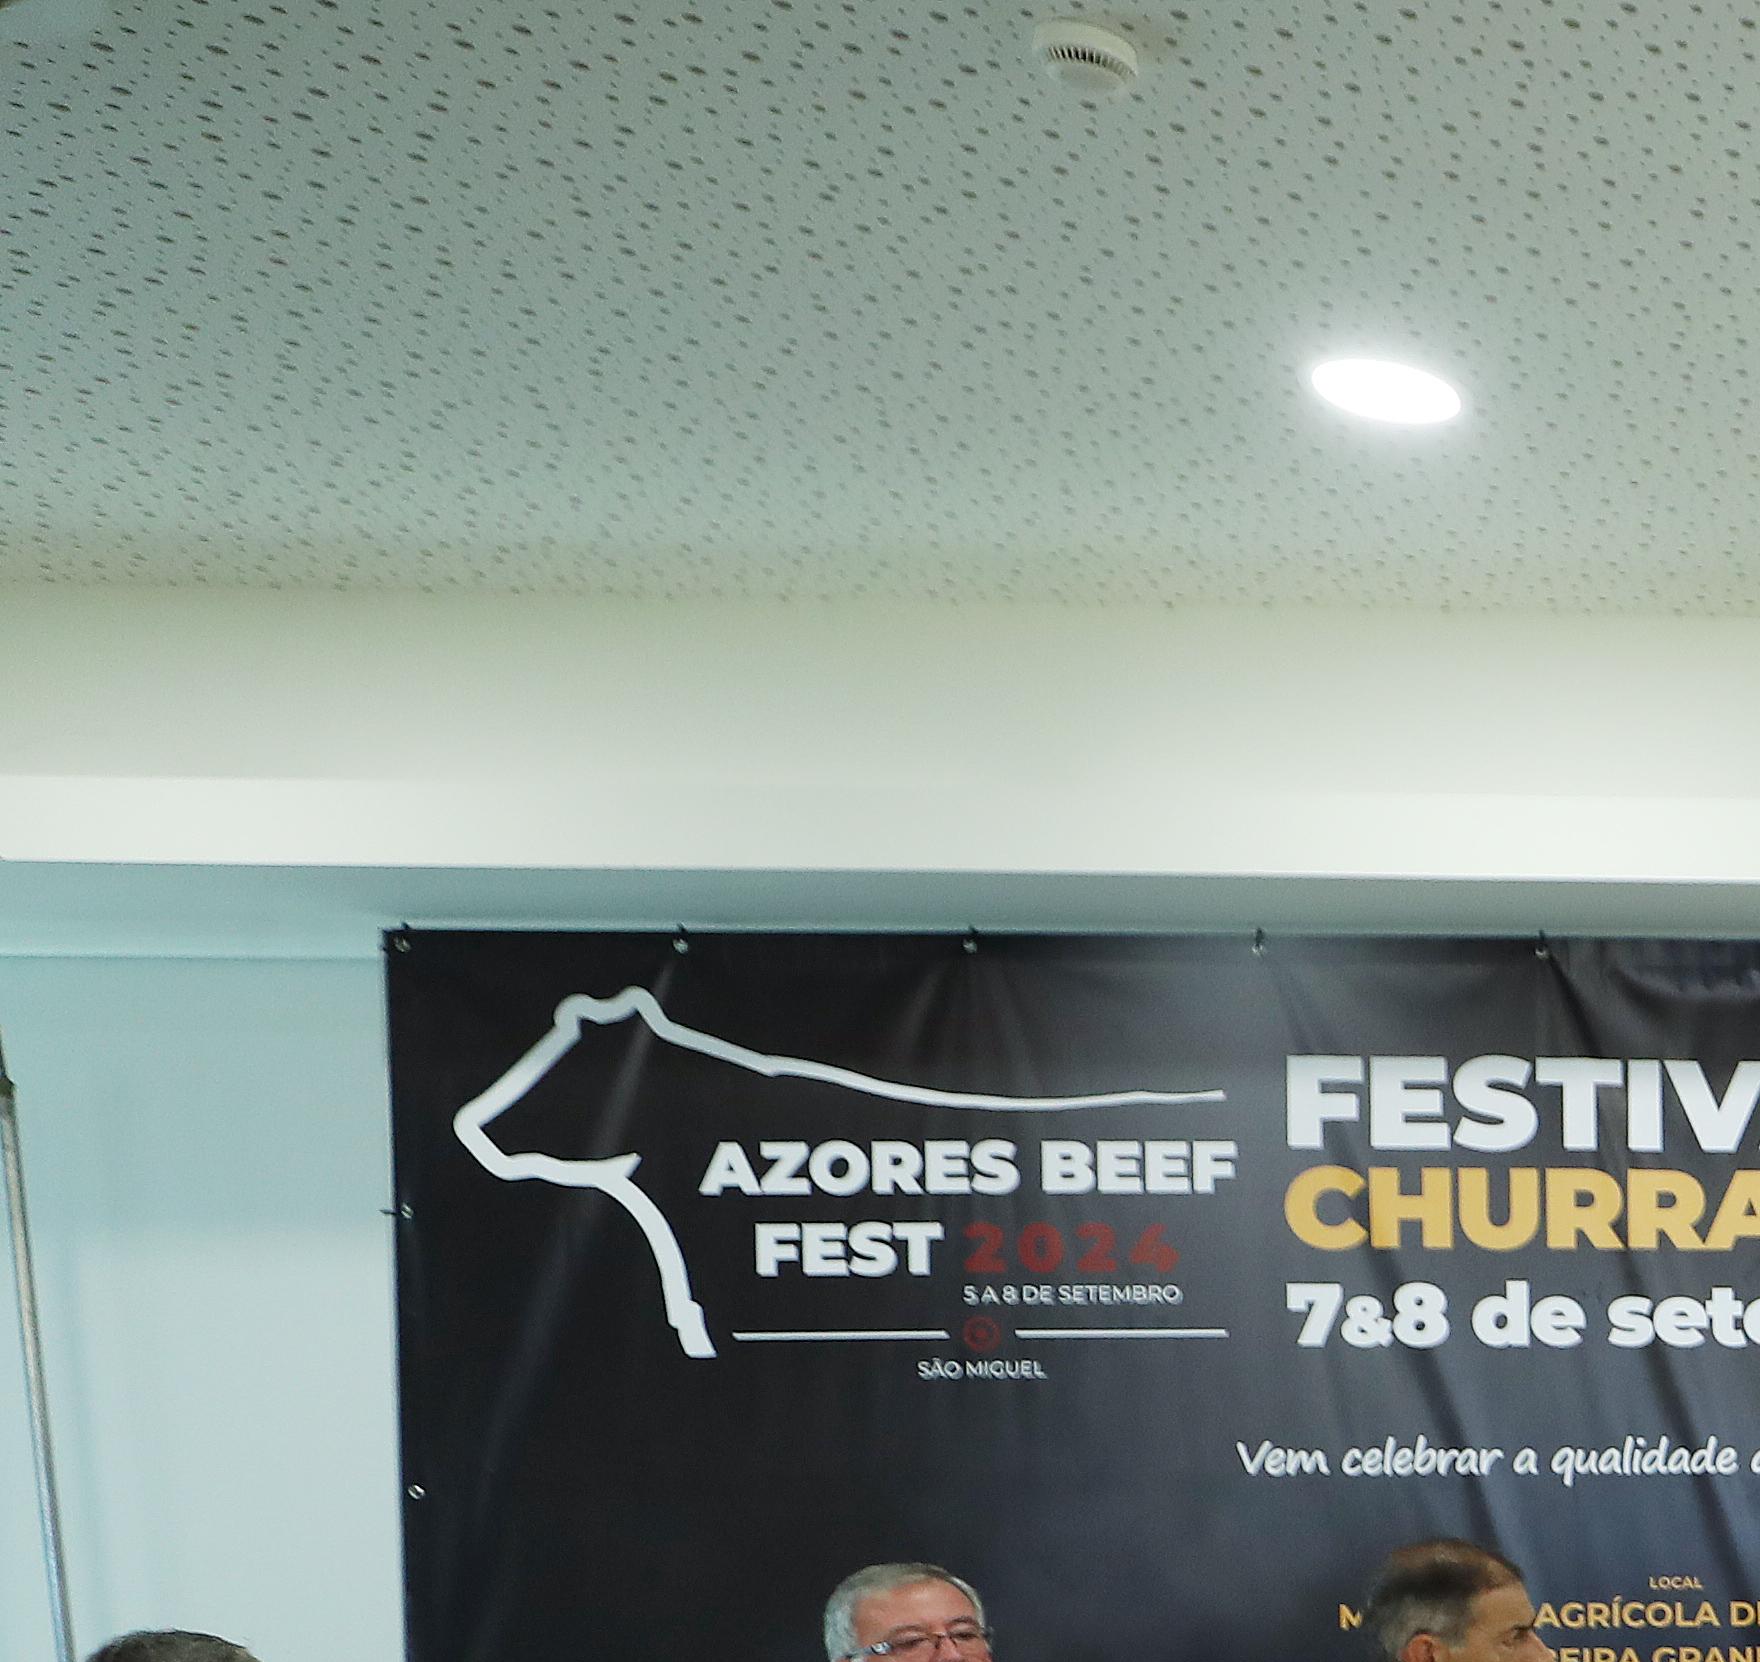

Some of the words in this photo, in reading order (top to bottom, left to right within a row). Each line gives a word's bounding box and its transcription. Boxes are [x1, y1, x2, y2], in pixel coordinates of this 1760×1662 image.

[699, 1140, 1021, 1197] AZORES
[1041, 1140, 1239, 1195] BEEF
[755, 1222, 945, 1277] FEST
[964, 1222, 1180, 1273] 2024
[981, 1285, 1001, 1306] A
[1002, 1284, 1020, 1306] 8
[1022, 1285, 1055, 1306] DE
[1058, 1284, 1184, 1306] SETEMBRO
[1286, 1282, 1451, 1348] 7&8
[1471, 1280, 1587, 1349] de
[917, 1357, 963, 1380] SÃO
[964, 1360, 1047, 1380] MIGUEL
[1236, 1439, 1331, 1478] Vem
[1341, 1434, 1504, 1478] celebrar
[1513, 1448, 1540, 1477] a
[1551, 1435, 1740, 1488] qualidade
[1648, 1576, 1703, 1590] LOCAL
[1534, 1594, 1721, 1631] AGRÍCOLA
